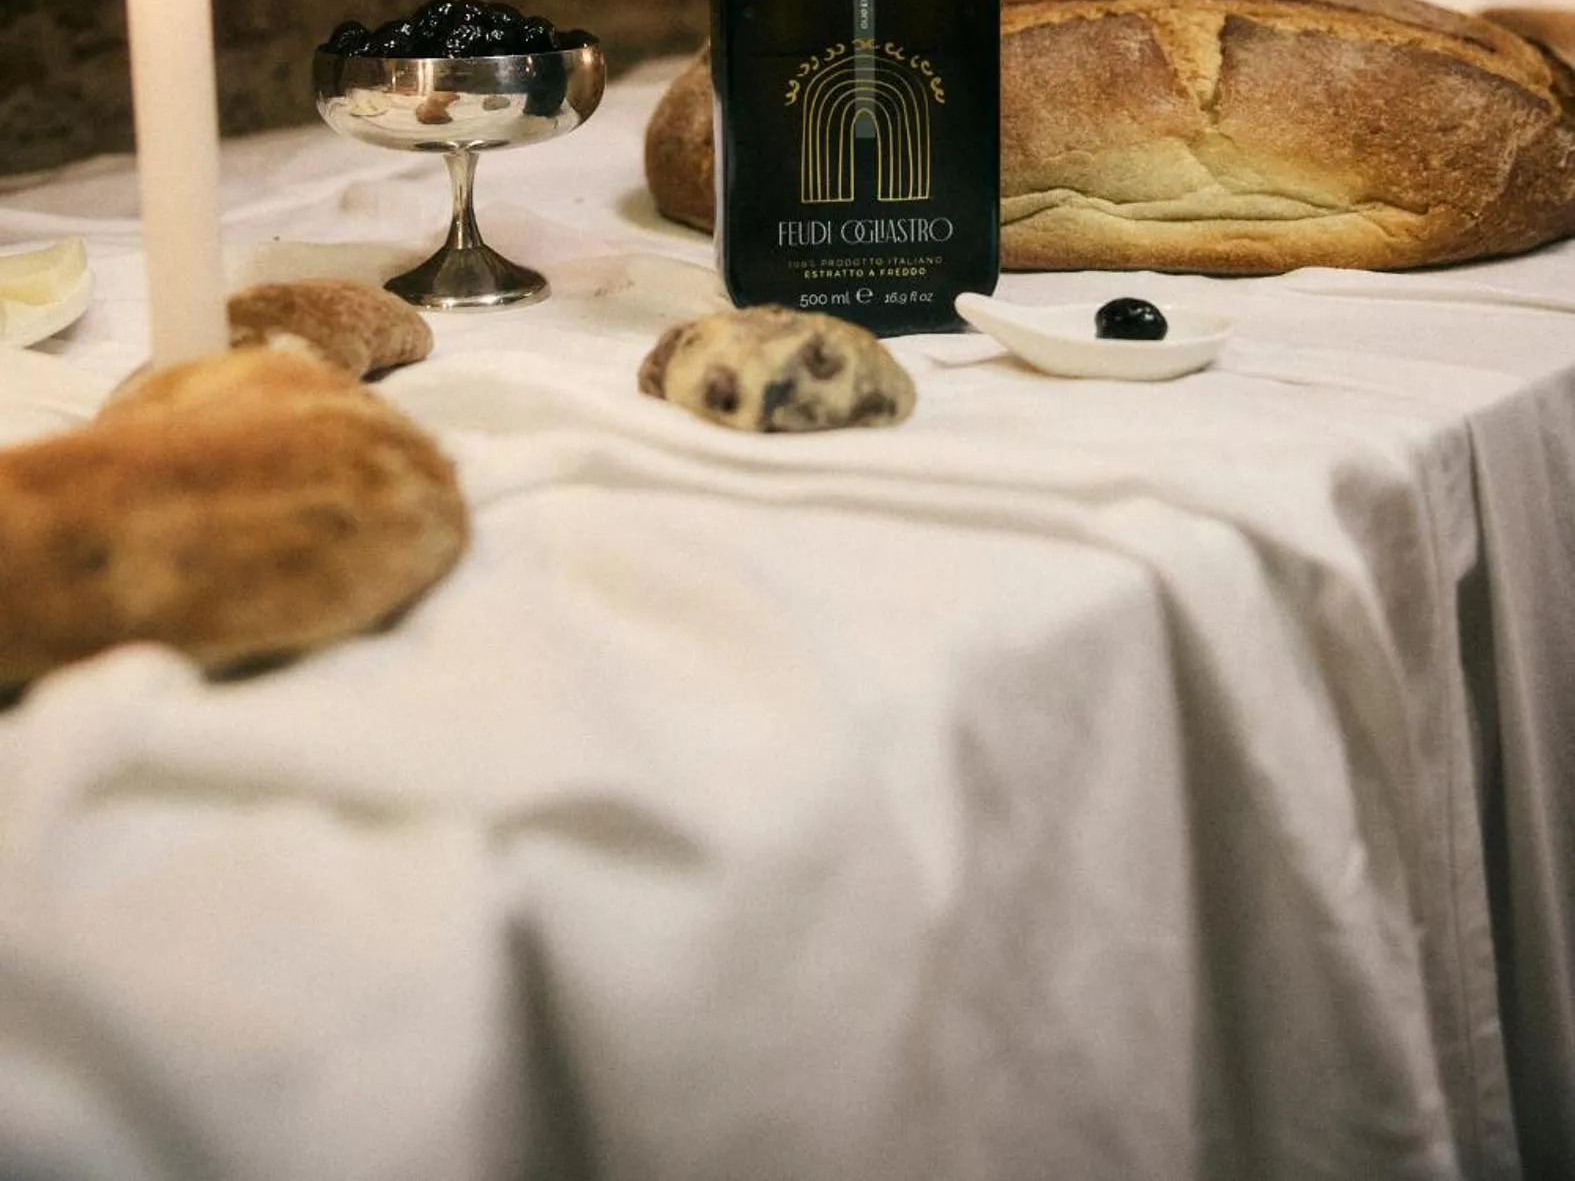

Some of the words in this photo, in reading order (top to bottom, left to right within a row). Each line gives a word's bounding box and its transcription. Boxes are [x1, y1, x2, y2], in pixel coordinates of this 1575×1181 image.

[860, 9, 868, 29] OLIO
[778, 221, 832, 246] FEUDI
[841, 217, 953, 244] OGLIASTRO
[821, 257, 884, 268] PRODOTTO
[888, 255, 943, 265] ITALIANO
[804, 269, 864, 279] ESTRATTO
[869, 268, 875, 277] A
[880, 267, 927, 276] FREDDO
[800, 294, 828, 307] 500
[831, 291, 850, 305] ml
[919, 292, 934, 302] oz
